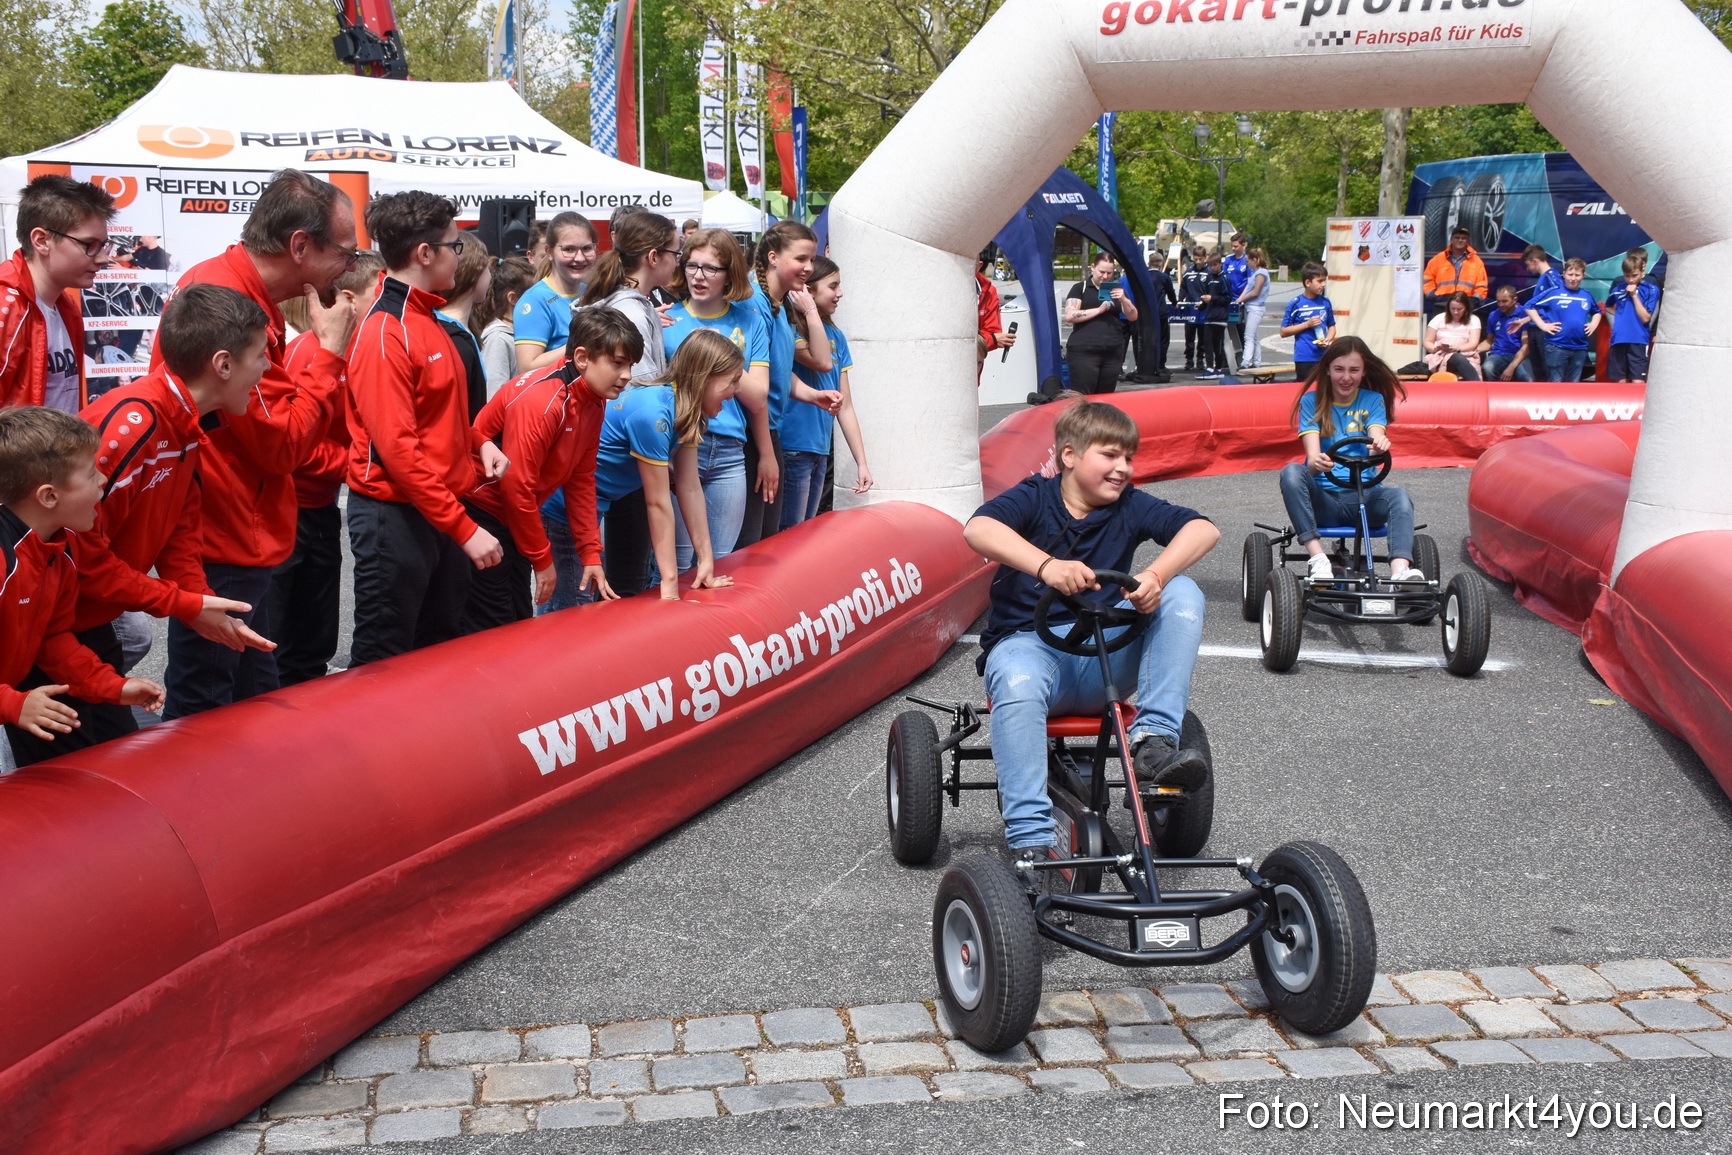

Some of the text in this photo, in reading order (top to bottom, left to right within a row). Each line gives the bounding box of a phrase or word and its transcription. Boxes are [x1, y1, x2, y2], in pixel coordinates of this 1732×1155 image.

[1100, 0, 1526, 35] gokart-pro.
[1355, 23, 1524, 46] Fahrspaß für Kids
[240, 128, 567, 156] REIFEN LORENZ
[308, 147, 513, 168] AUTO SERVICE
[146, 177, 226, 195] REIFEN
[182, 199, 228, 212] AUTO
[1042, 193, 1085, 203] FALKEN
[1566, 203, 1627, 216] FALK
[88, 320, 129, 328] KFZ-SERVICE
[518, 557, 922, 776] www.gokart-profi.de
[1147, 928, 1188, 939] BERG
